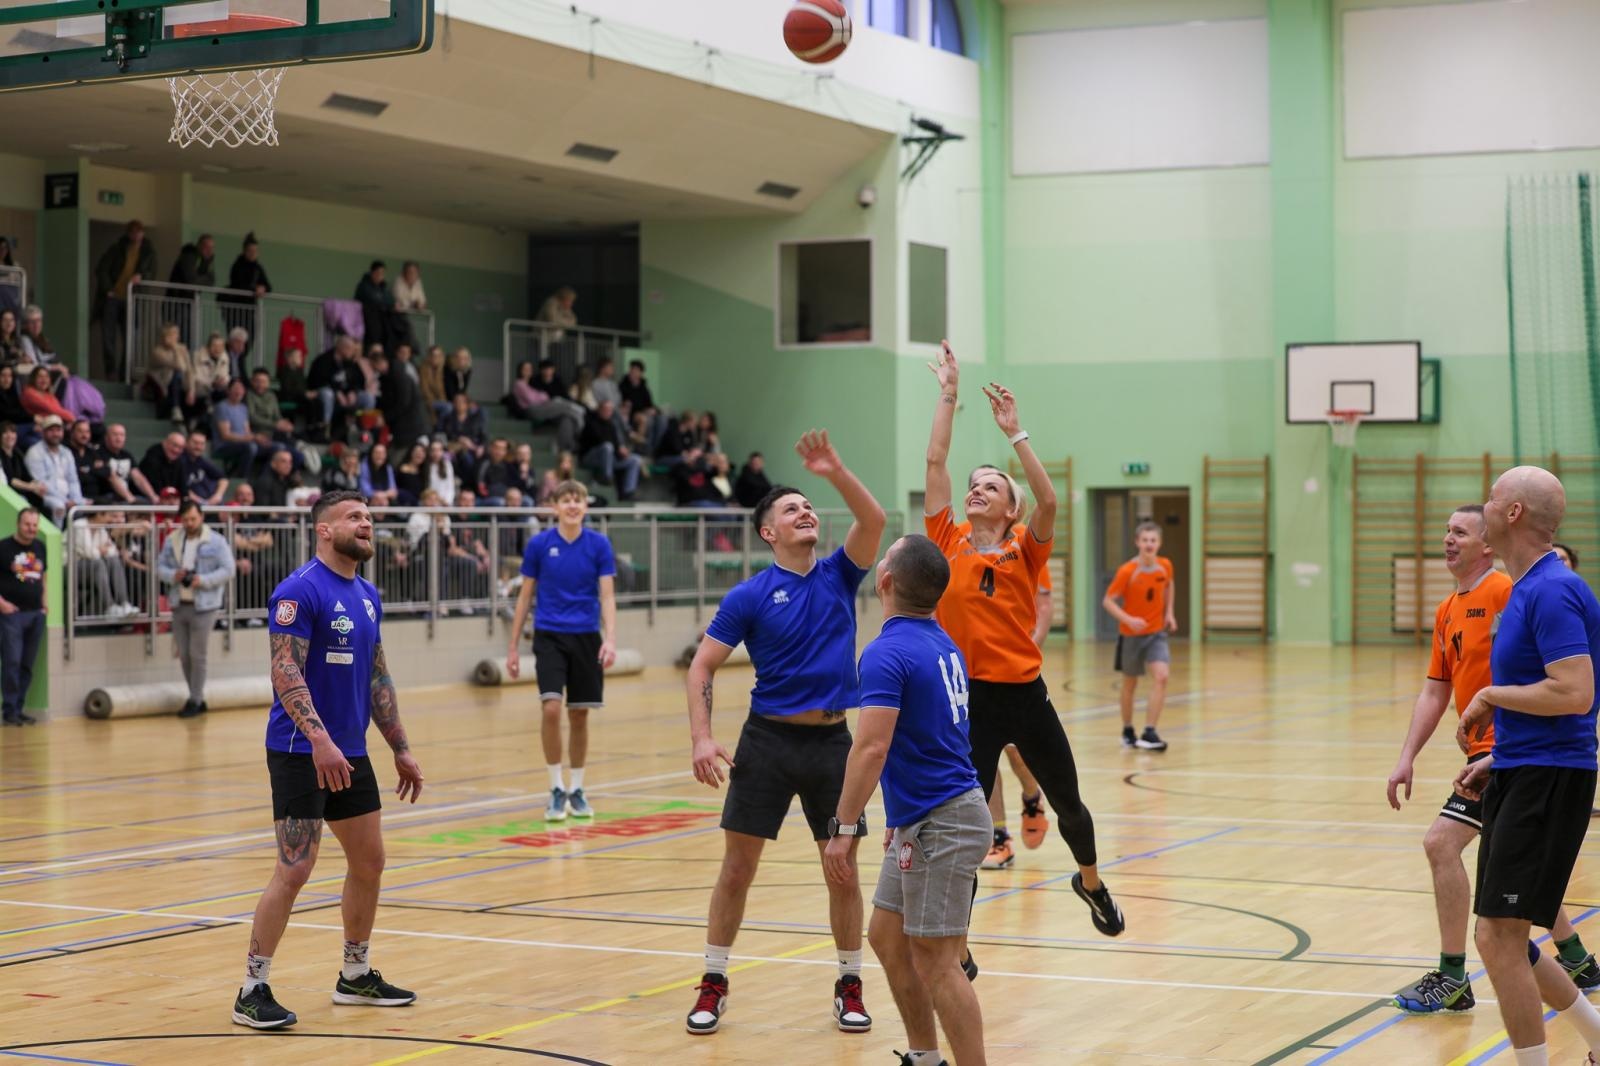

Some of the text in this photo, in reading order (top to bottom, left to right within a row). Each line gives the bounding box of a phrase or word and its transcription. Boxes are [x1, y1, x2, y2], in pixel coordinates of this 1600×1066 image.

[53, 185, 71, 206] F
[979, 566, 996, 598] 4
[938, 651, 969, 725] 14
